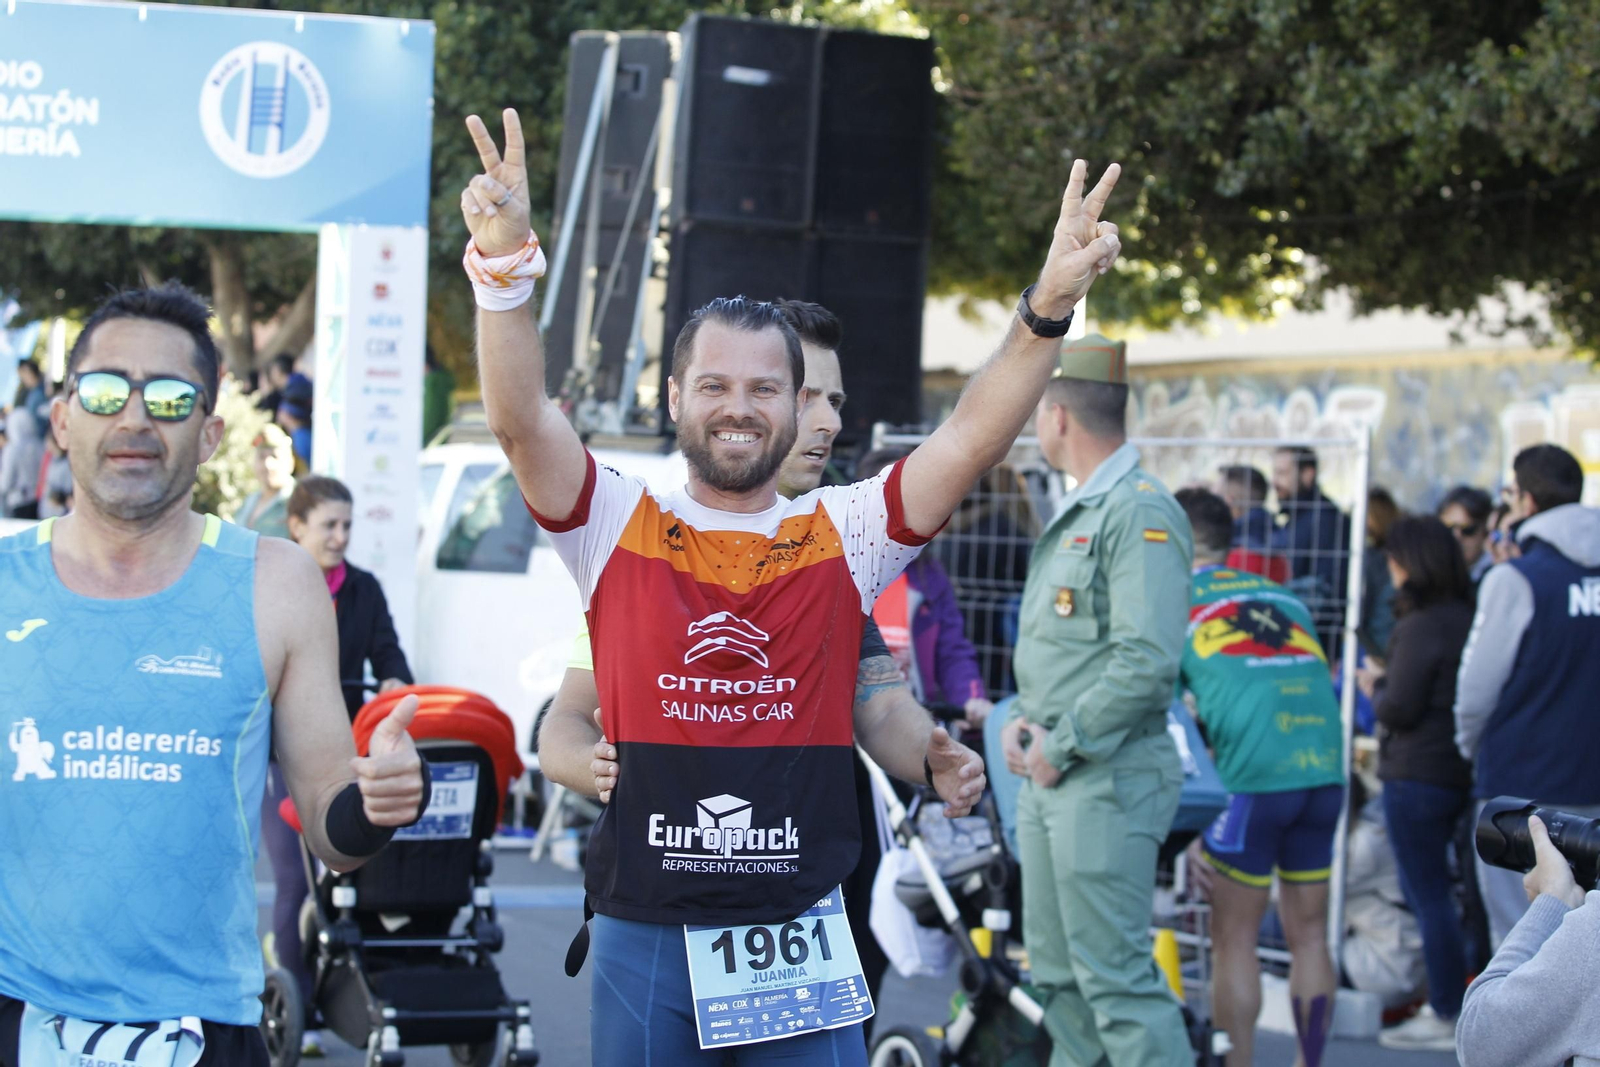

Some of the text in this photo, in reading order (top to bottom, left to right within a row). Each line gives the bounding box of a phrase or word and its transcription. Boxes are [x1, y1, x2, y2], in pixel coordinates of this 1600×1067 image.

[0, 122, 81, 157] ERÍA
[657, 674, 797, 695] CITROËN
[661, 700, 795, 723] SALINAS CAR
[62, 725, 222, 756] caldererías
[63, 754, 182, 783] indálicas
[431, 788, 457, 807] ETA
[648, 813, 799, 859] Europack
[662, 859, 790, 873] REPRESENTACIONES
[711, 918, 833, 974] 1961
[751, 966, 808, 984] JUANMA
[708, 998, 749, 1013] NEXA CDX
